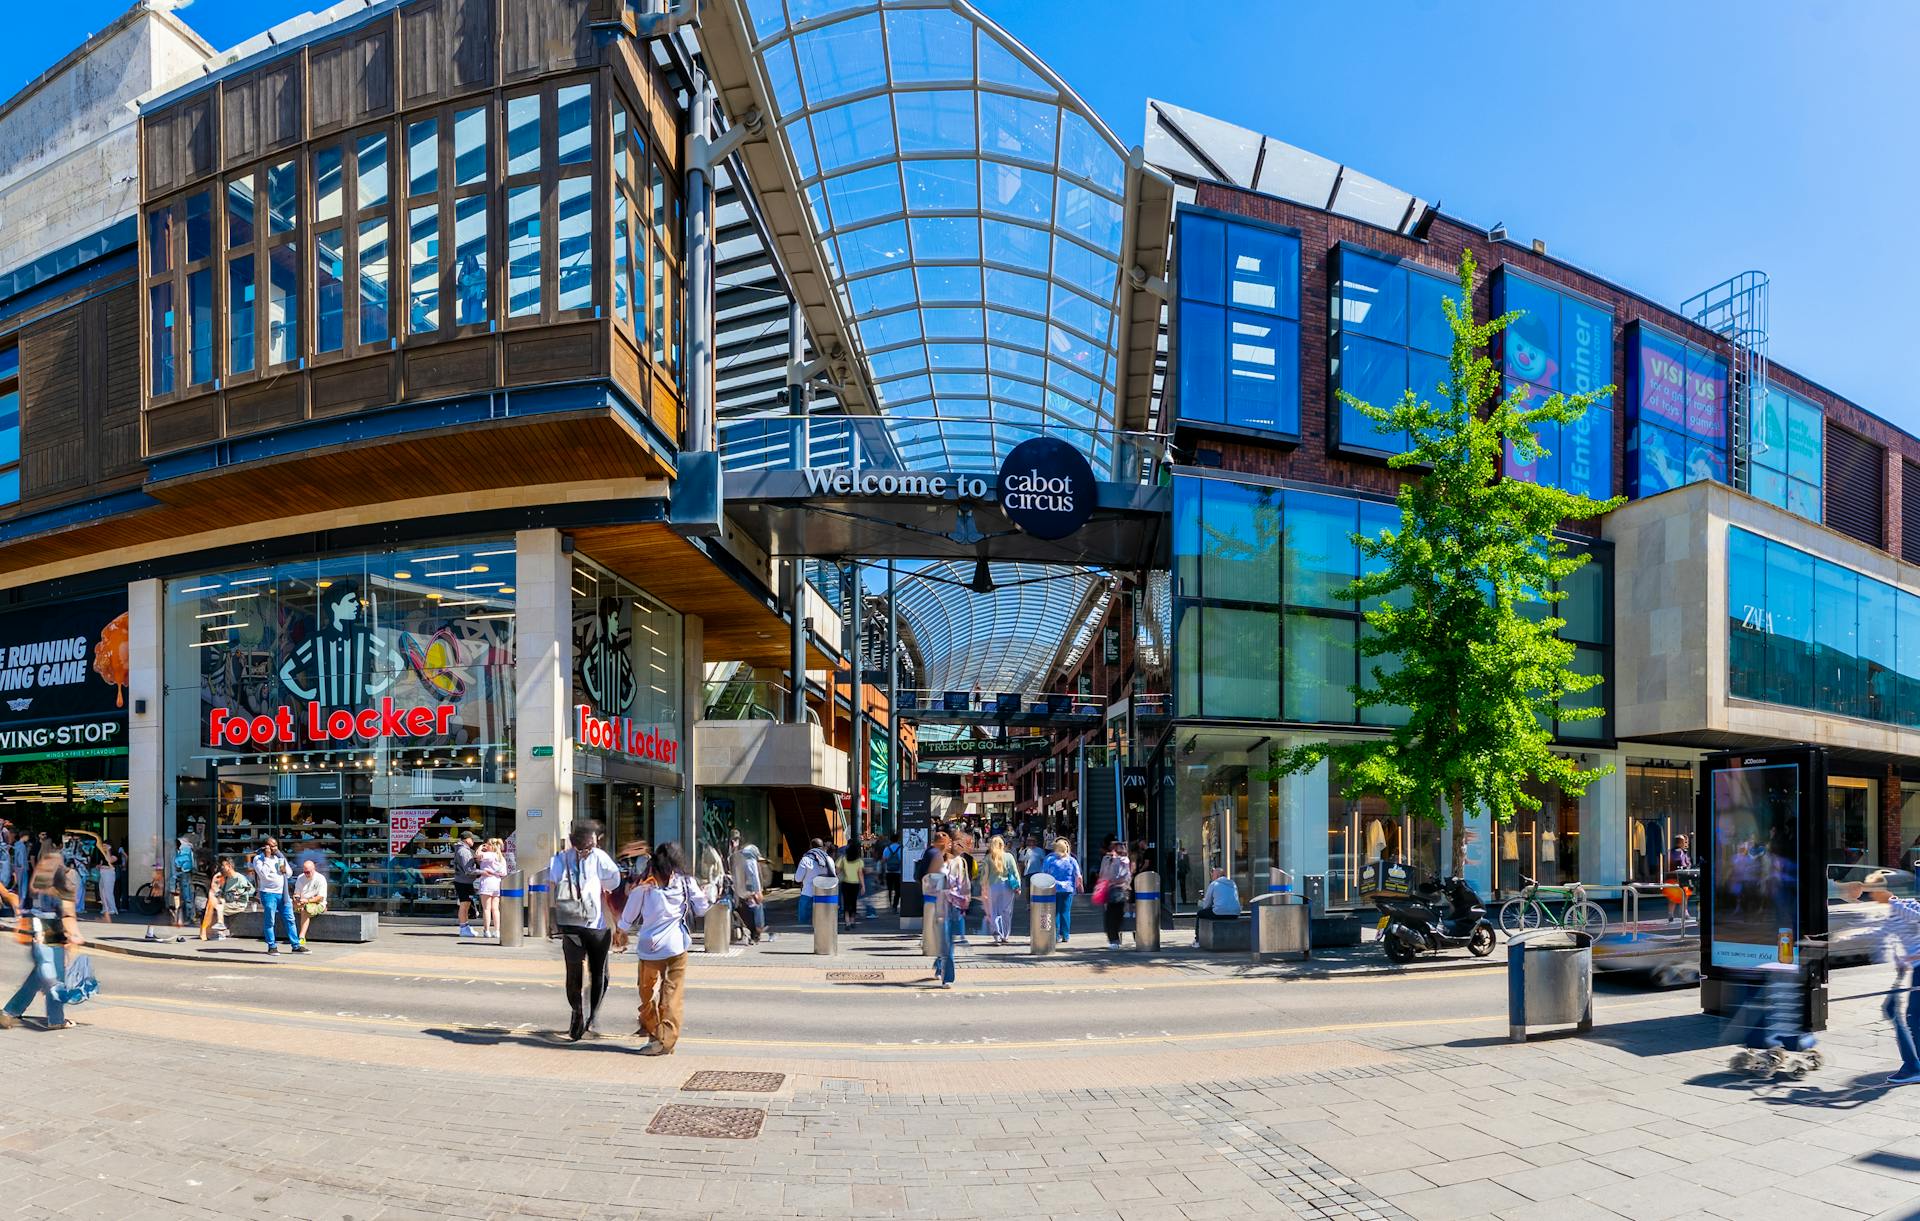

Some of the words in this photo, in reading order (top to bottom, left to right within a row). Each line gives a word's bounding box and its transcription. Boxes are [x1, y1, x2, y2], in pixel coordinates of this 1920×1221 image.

[1695, 379, 1715, 401] US
[802, 467, 946, 496] Welcome
[956, 475, 988, 497] to
[1004, 469, 1074, 494] cabot
[1004, 490, 1074, 512] circus
[8, 636, 87, 668] RUNNING
[37, 660, 88, 687] GAME
[210, 705, 295, 746] Foot
[308, 695, 457, 741] Locker
[577, 704, 622, 752] Foot
[624, 717, 679, 765] Locker
